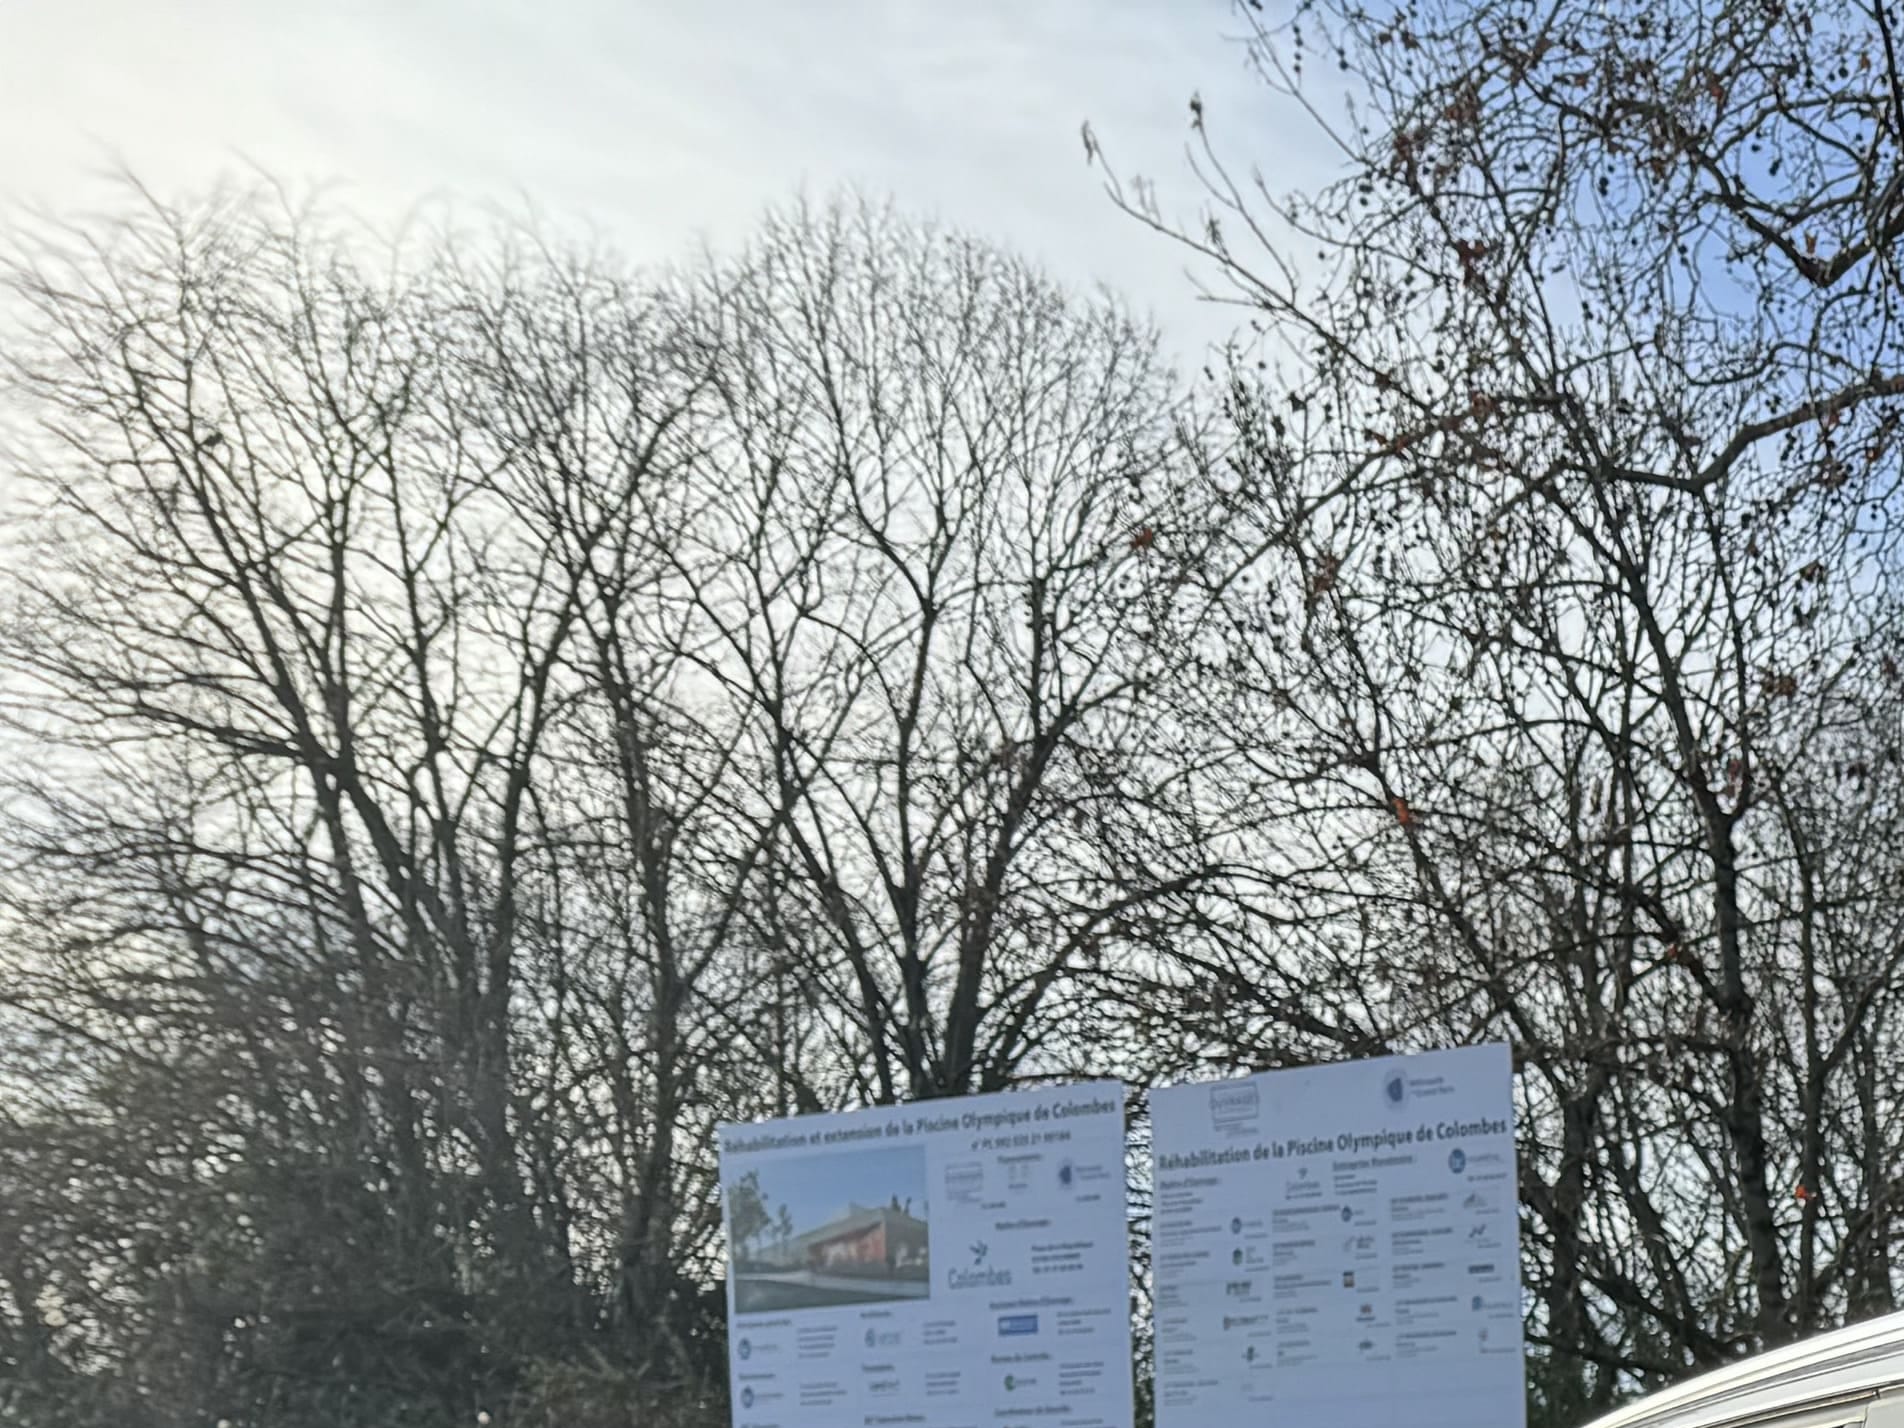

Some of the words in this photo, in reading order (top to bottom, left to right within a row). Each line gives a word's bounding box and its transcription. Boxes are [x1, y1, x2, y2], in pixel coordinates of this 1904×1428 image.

[886, 1120, 899, 1137] de
[902, 1118, 914, 1136] la
[917, 1113, 959, 1134] Piscine
[961, 1108, 1030, 1131] Olympique
[1034, 1103, 1049, 1122] de
[1053, 1096, 1116, 1120] Colombes
[1253, 1141, 1269, 1161] de
[1272, 1139, 1285, 1159] la
[1287, 1135, 1334, 1157] Piscine
[1337, 1127, 1413, 1153] Olympique
[1416, 1122, 1433, 1142] de
[1436, 1115, 1507, 1141] Colombes
[948, 1264, 1012, 1290] Colombes
